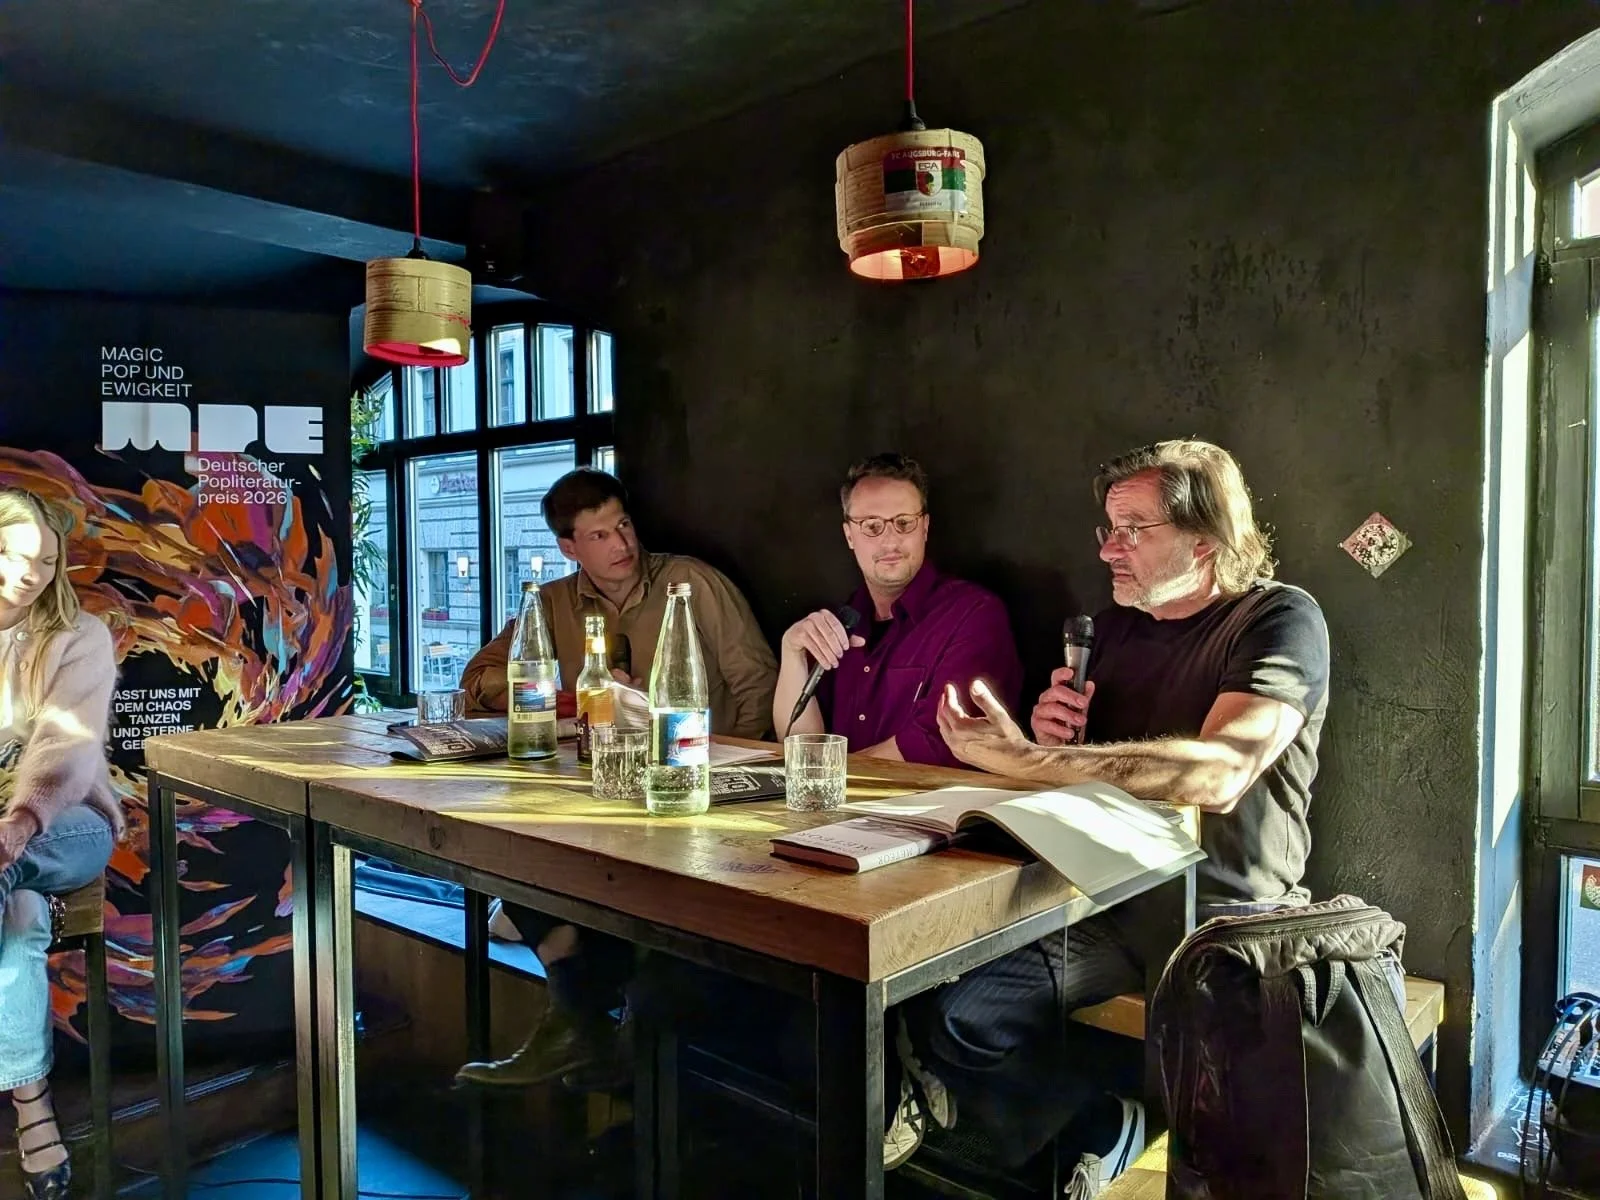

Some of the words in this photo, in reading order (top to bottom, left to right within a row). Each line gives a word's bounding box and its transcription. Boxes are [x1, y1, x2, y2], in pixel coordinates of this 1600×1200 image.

[101, 346, 163, 362] MAGIC
[101, 364, 141, 379] POP
[145, 365, 184, 380] UND
[101, 381, 192, 398] EWIGKEIT
[198, 458, 285, 473] Deutscher
[198, 474, 302, 490] Popliteratur-
[198, 491, 239, 506] preis
[243, 491, 287, 505] 2026
[113, 690, 147, 700] ASST
[149, 688, 177, 699] UNS
[178, 687, 201, 698] MIT
[115, 702, 144, 713] DEM
[146, 701, 192, 712] CHAOS
[129, 713, 181, 725] TANZEN
[113, 727, 140, 738] UND
